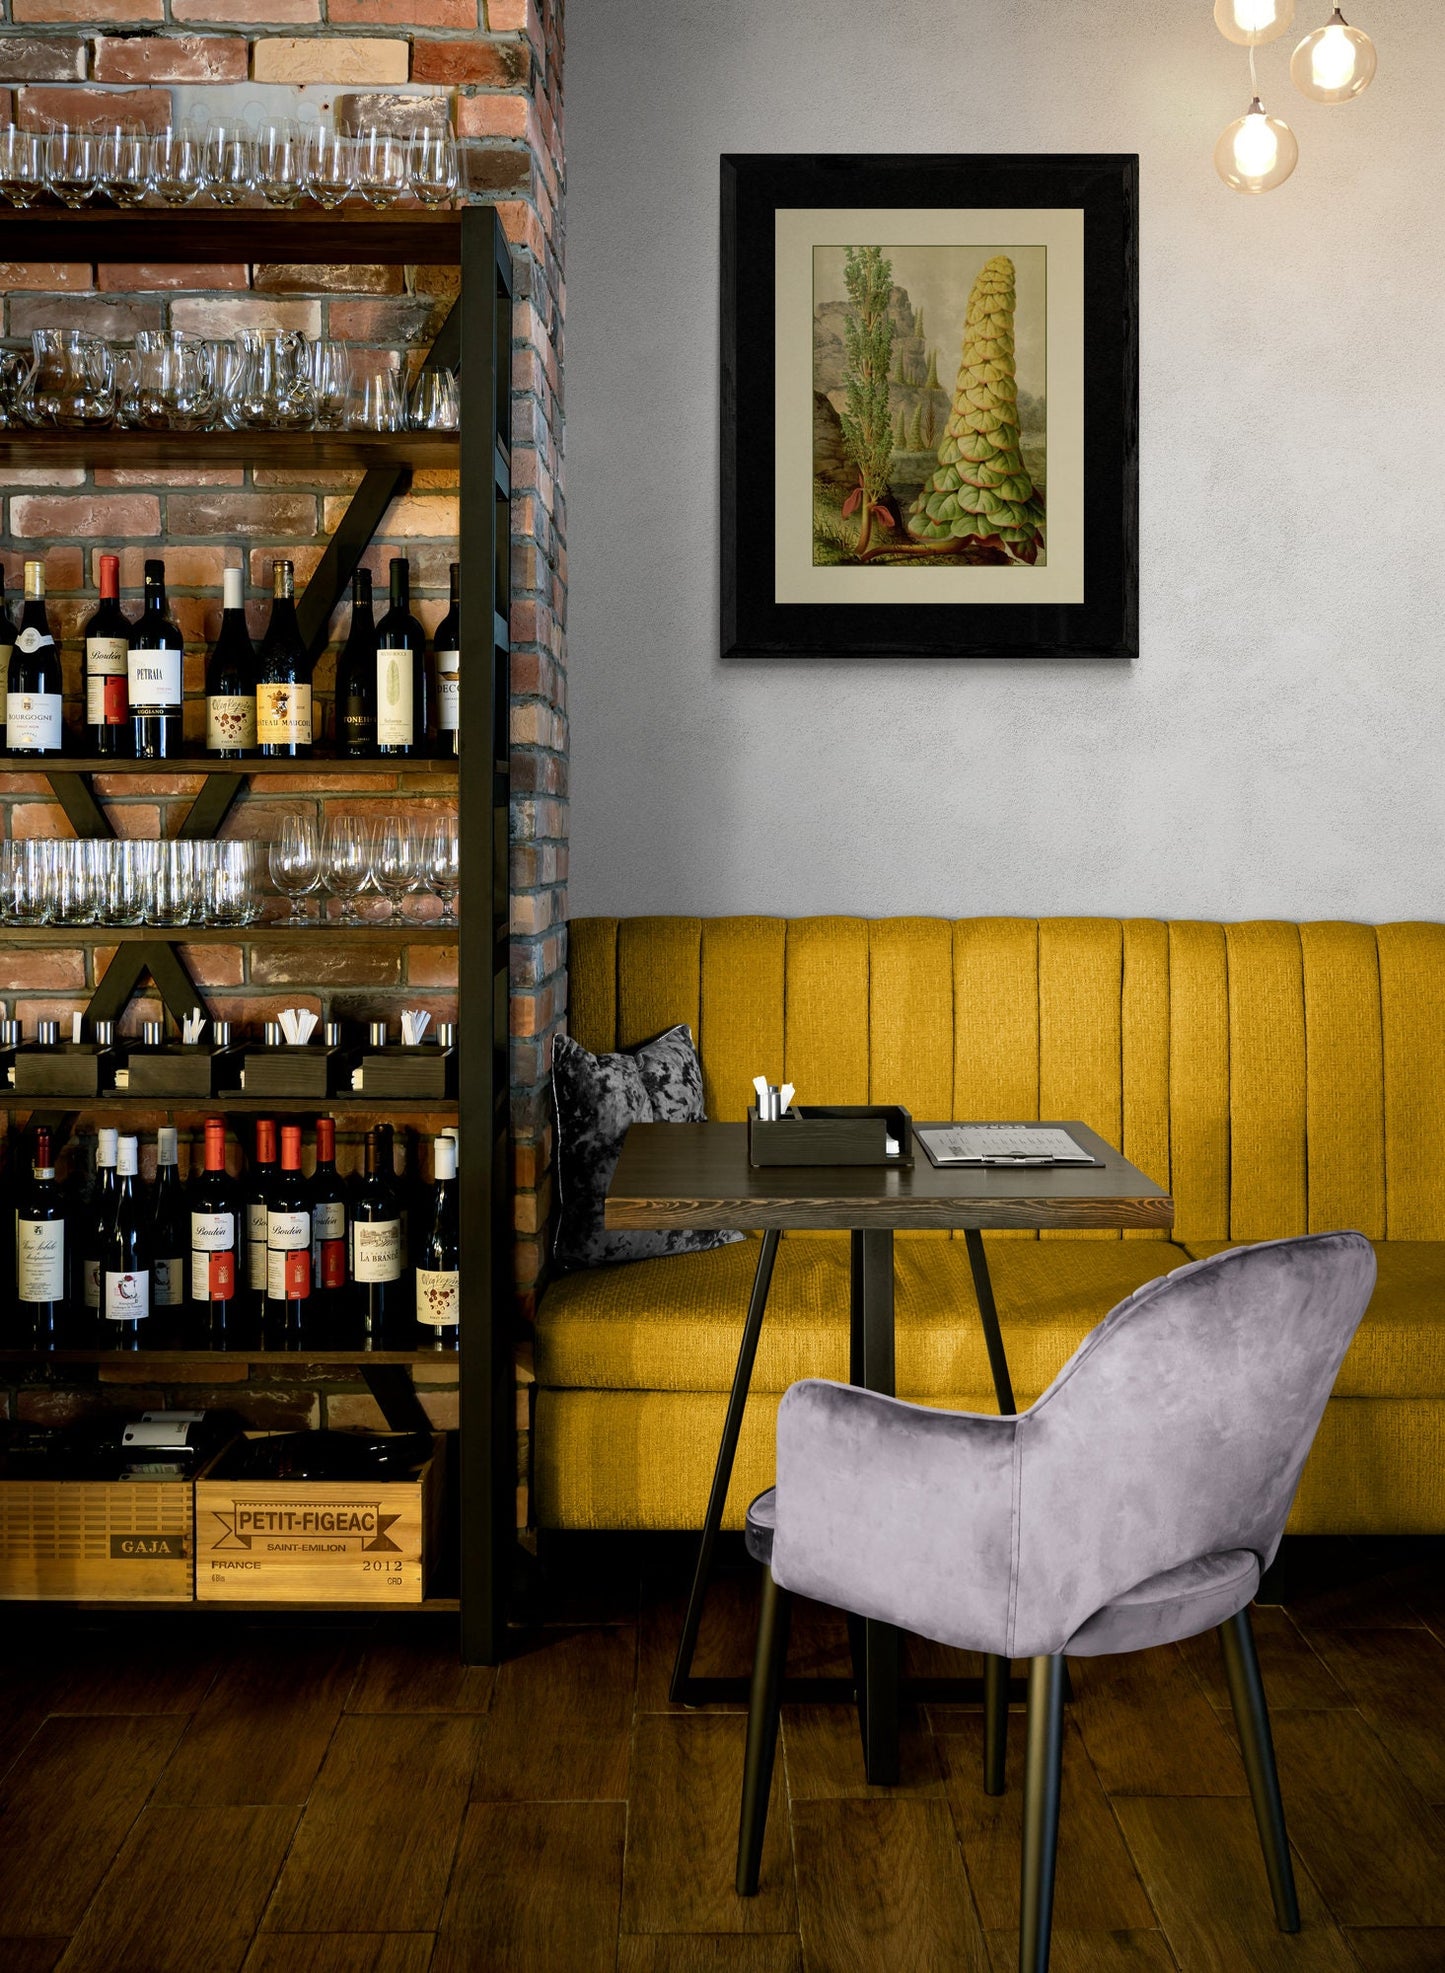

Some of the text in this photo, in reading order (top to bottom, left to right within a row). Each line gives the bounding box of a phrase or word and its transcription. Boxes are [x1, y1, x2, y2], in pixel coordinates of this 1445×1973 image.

[9, 713, 52, 721] BOURGOGNE
[196, 1226, 226, 1236] Bordón
[272, 1226, 302, 1235] Bordón
[239, 1511, 375, 1531] PETIT-FIGEAC
[121, 1540, 172, 1553] GAJA
[267, 1543, 346, 1552] SAINT-EMILION
[211, 1560, 403, 1571] FRANCE 2012
